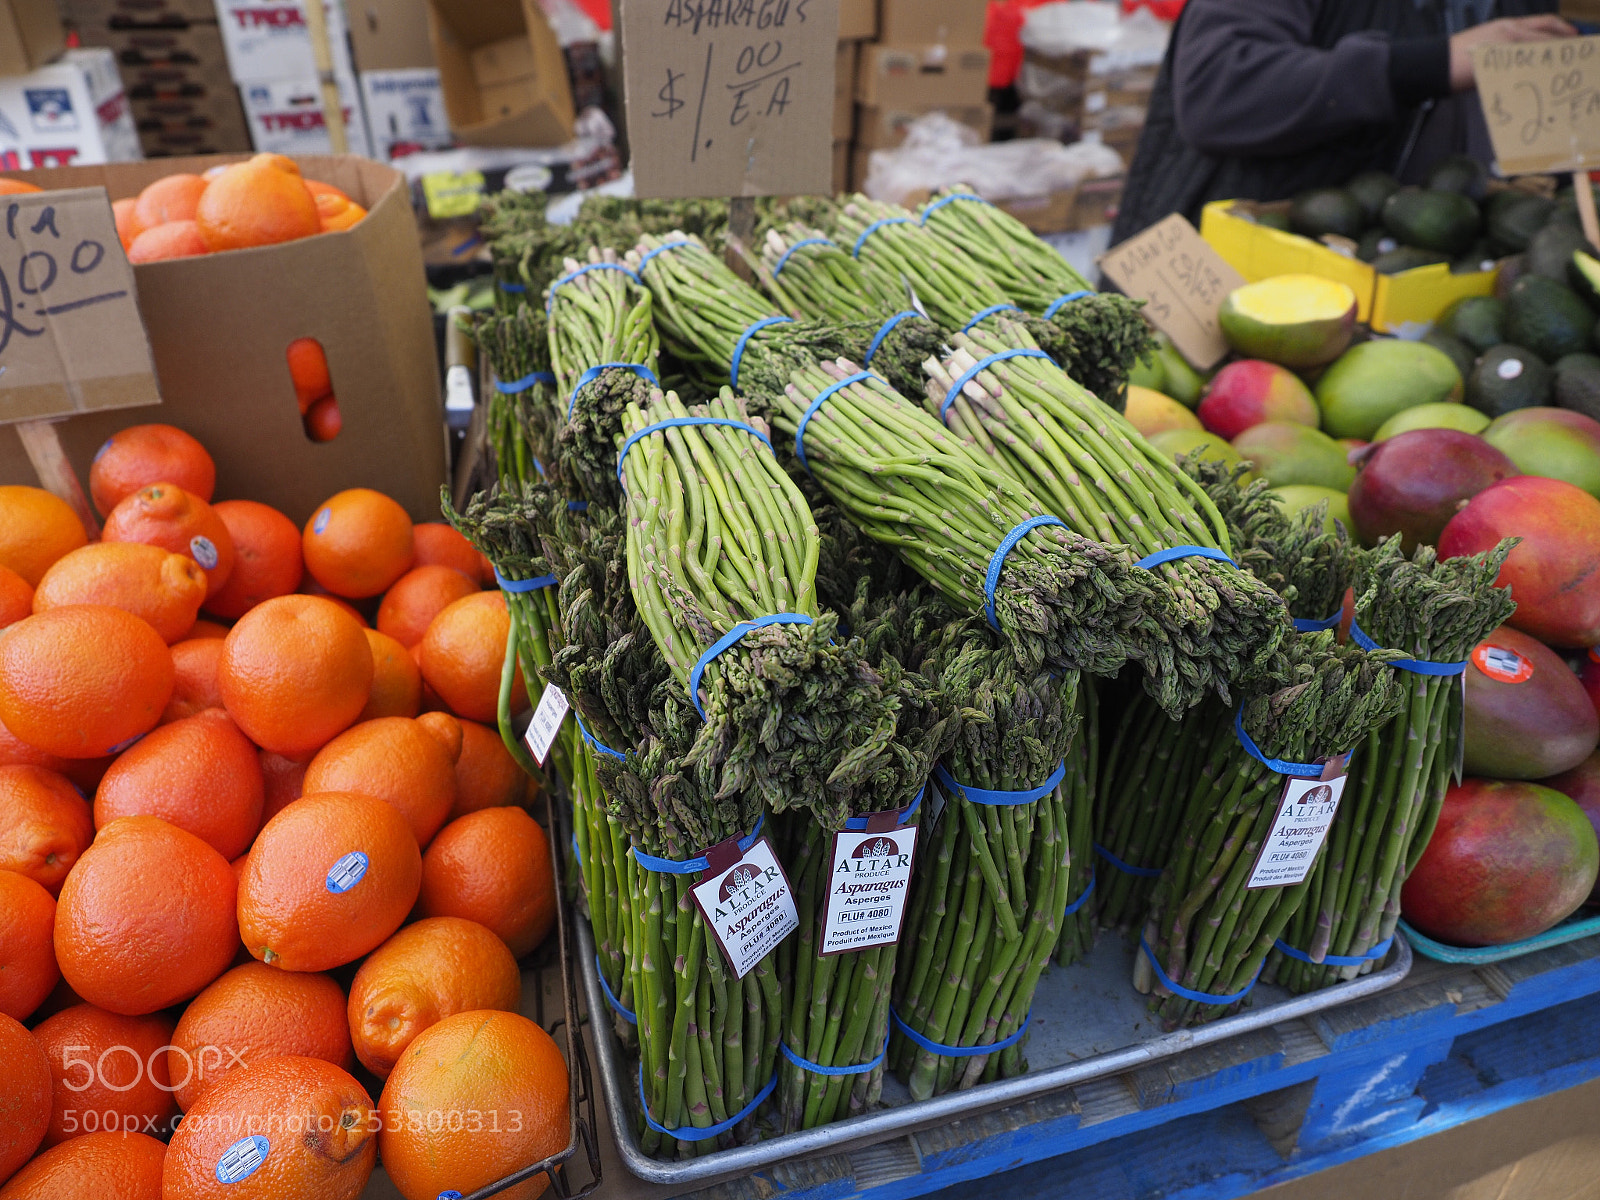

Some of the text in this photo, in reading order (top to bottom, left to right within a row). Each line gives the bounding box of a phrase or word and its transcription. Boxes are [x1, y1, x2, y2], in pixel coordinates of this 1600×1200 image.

[1281, 801, 1336, 817] ALTAR
[1274, 824, 1327, 840] Asparagus
[1278, 839, 1313, 848] Asperges
[836, 853, 910, 873] ALTAR
[1270, 853, 1289, 861] PLU#
[854, 870, 890, 879] PRODUCE
[714, 865, 780, 923] ALTAR
[834, 879, 906, 896] Asparagus
[733, 889, 767, 917] PRODUCE
[844, 895, 891, 905] Asperges
[726, 886, 786, 941] Asparagus
[841, 908, 889, 922] PLU# 4080
[740, 904, 780, 941] Asperges
[743, 913, 784, 953] PLU# 4080
[827, 937, 852, 947] Produit
[867, 931, 895, 941] Mexique
[832, 929, 859, 938] Product
[869, 924, 893, 932] Mexico
[741, 943, 765, 966] Product
